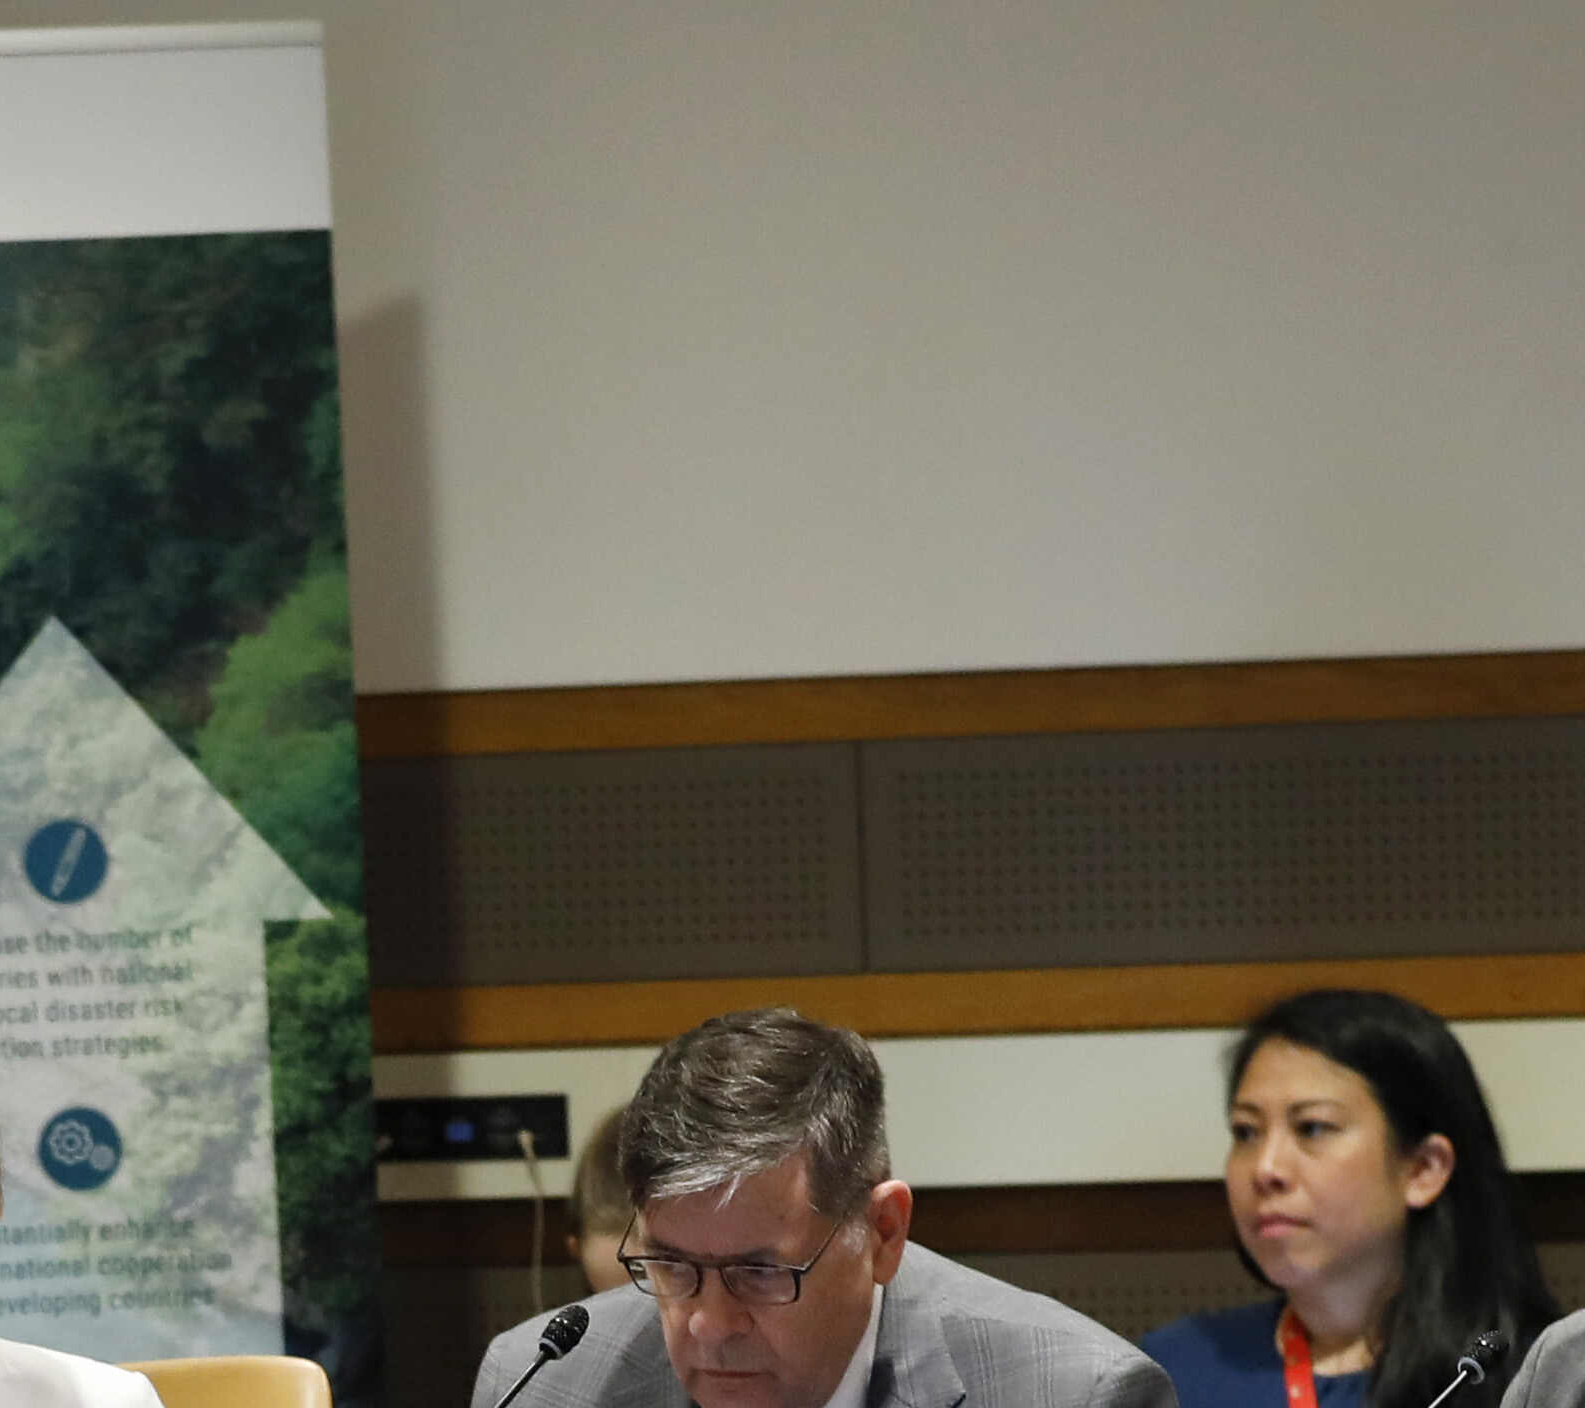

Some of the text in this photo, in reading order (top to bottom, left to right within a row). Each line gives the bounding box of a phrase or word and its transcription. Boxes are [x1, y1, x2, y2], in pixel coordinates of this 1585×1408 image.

[35, 927, 72, 952] the
[47, 964, 94, 987] with
[100, 960, 194, 986] national
[44, 997, 138, 1023] disaster
[98, 1250, 233, 1281] cooperation
[110, 1286, 217, 1312] countries
